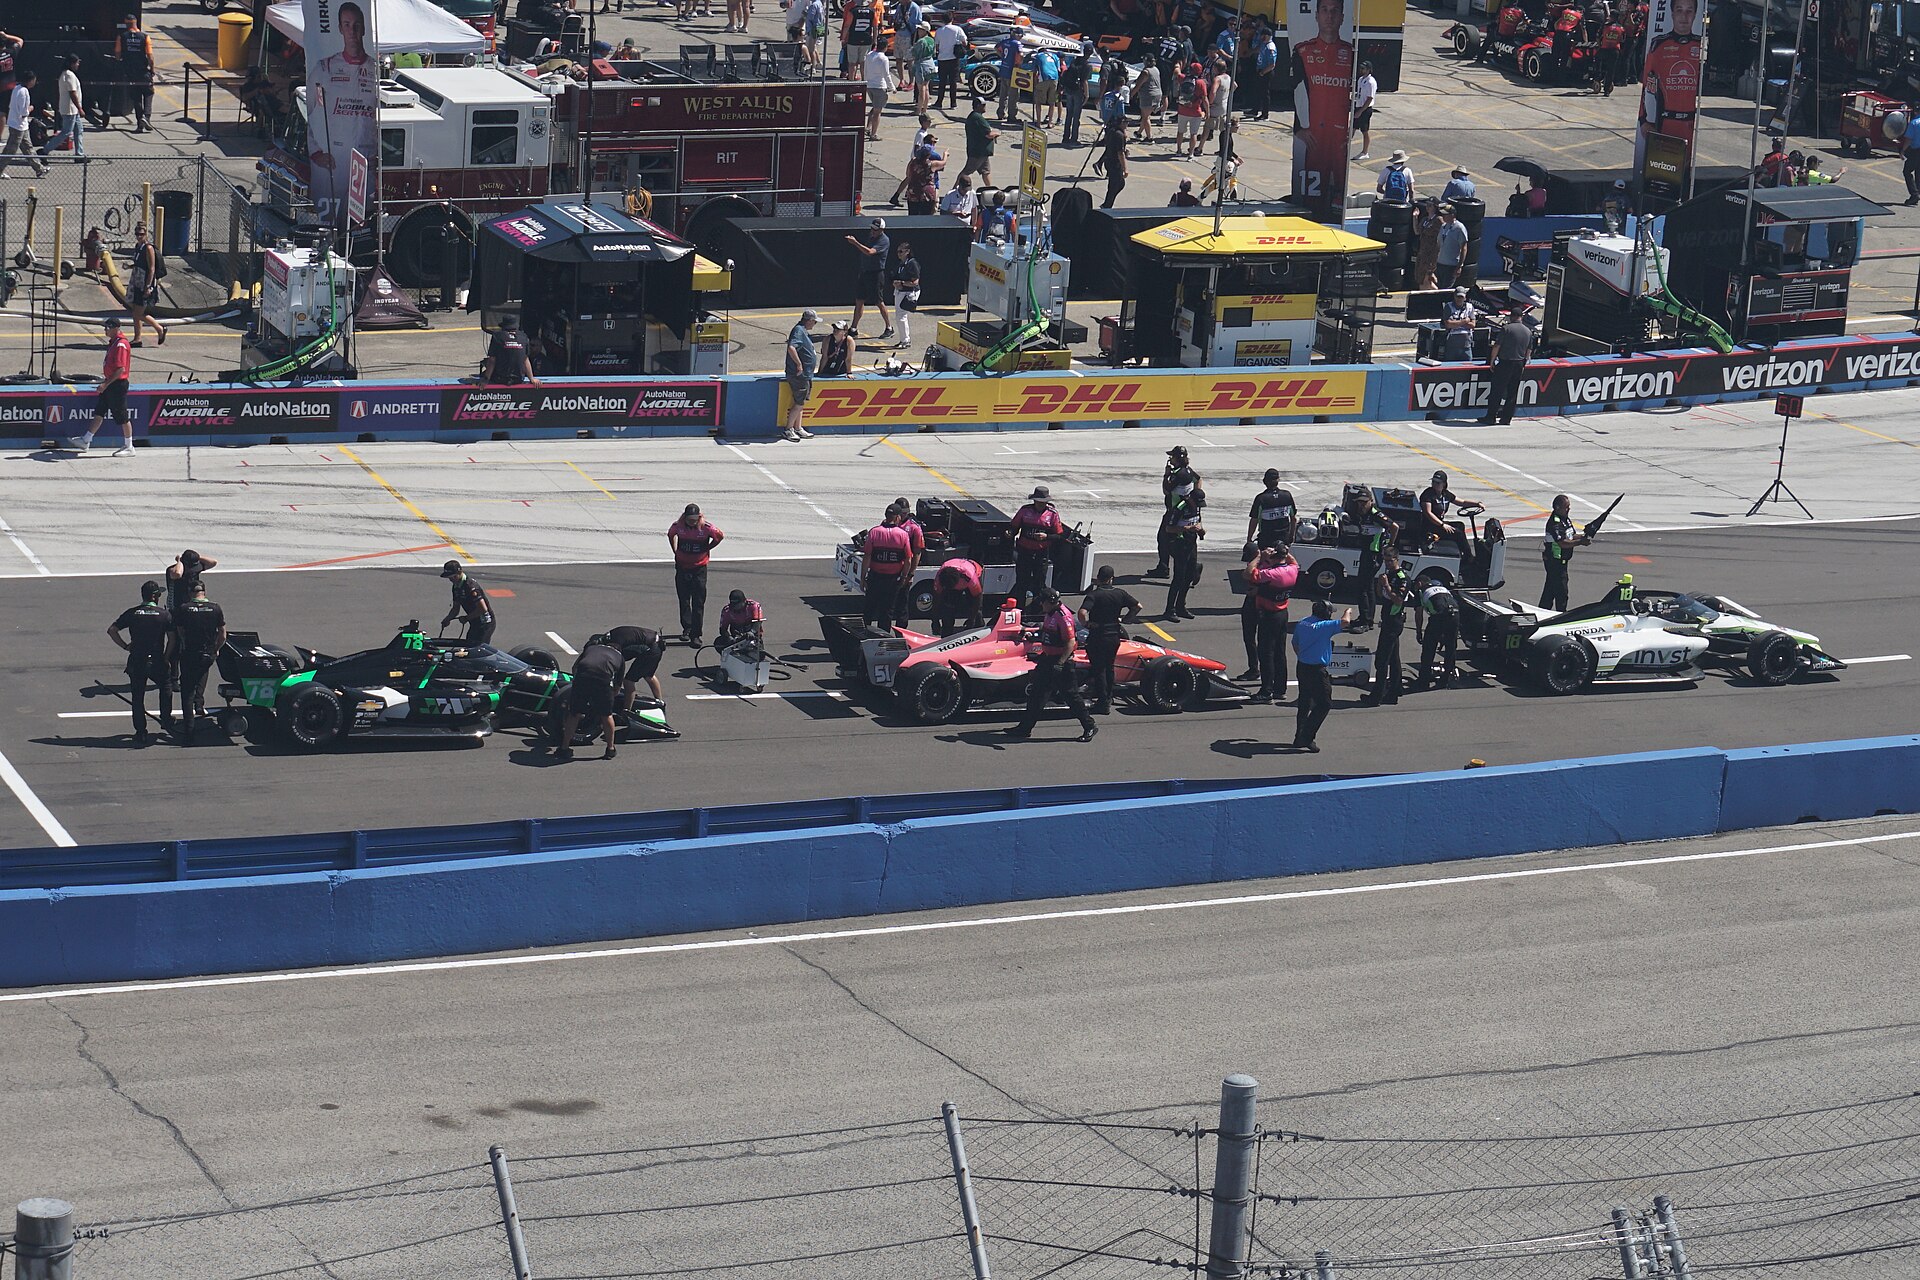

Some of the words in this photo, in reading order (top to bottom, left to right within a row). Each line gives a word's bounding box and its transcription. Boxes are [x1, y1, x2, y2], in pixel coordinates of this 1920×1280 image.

[1015, 71, 1031, 88] 10
[1311, 74, 1347, 87] verizon
[684, 96, 735, 115] WEST
[739, 95, 794, 114] ALLIS
[698, 113, 718, 121] FIRE
[721, 112, 776, 121] DEPARTMENT
[716, 152, 739, 164] RIT
[1650, 160, 1677, 172] verizon
[352, 159, 366, 197] 27
[1299, 169, 1321, 197] 12
[478, 182, 506, 191] ENGINE
[1725, 193, 1746, 206] verizon
[498, 223, 539, 247] SERVICE
[508, 219, 546, 241] MOBILE
[1255, 236, 1314, 245] DHL
[1502, 256, 1513, 273] 12
[1584, 249, 1616, 267] verizon
[980, 263, 1003, 282] DHL
[1753, 288, 1774, 296] verizon
[1819, 282, 1840, 291] verizon
[1249, 295, 1286, 304] DHL
[1469, 298, 1490, 310] HITACHI
[1244, 344, 1281, 354] DHL
[1246, 357, 1290, 366] GANASSI
[1414, 373, 1538, 408] verizn
[1567, 367, 1674, 402] verizon
[1722, 355, 1824, 391] verizon
[469, 393, 511, 401] AutoNation
[645, 390, 687, 398] AutoNation
[1017, 383, 1147, 415] DHL
[1206, 379, 1334, 411] DHL
[165, 398, 209, 406] AutoNation
[373, 402, 440, 415] ANDRETTI
[463, 402, 532, 411] MOBILE
[540, 395, 627, 411] AutoNation
[639, 399, 707, 409] MOBILE
[813, 387, 953, 418] DHL
[1777, 395, 1801, 414] 60
[160, 407, 232, 417] MOBILE
[240, 401, 330, 417] AutoNation
[461, 410, 538, 420] SERVICE
[635, 408, 711, 418] SERVICE
[155, 416, 237, 426] SERVICE
[1620, 587, 1633, 601] 18
[1005, 612, 1016, 624] 51
[1566, 626, 1606, 637] HONDA
[402, 633, 424, 650] 78
[938, 634, 981, 653] HONDA
[1506, 634, 1521, 649] 18
[1635, 647, 1692, 664] invst
[874, 663, 890, 683] 51
[247, 679, 277, 700] 78
